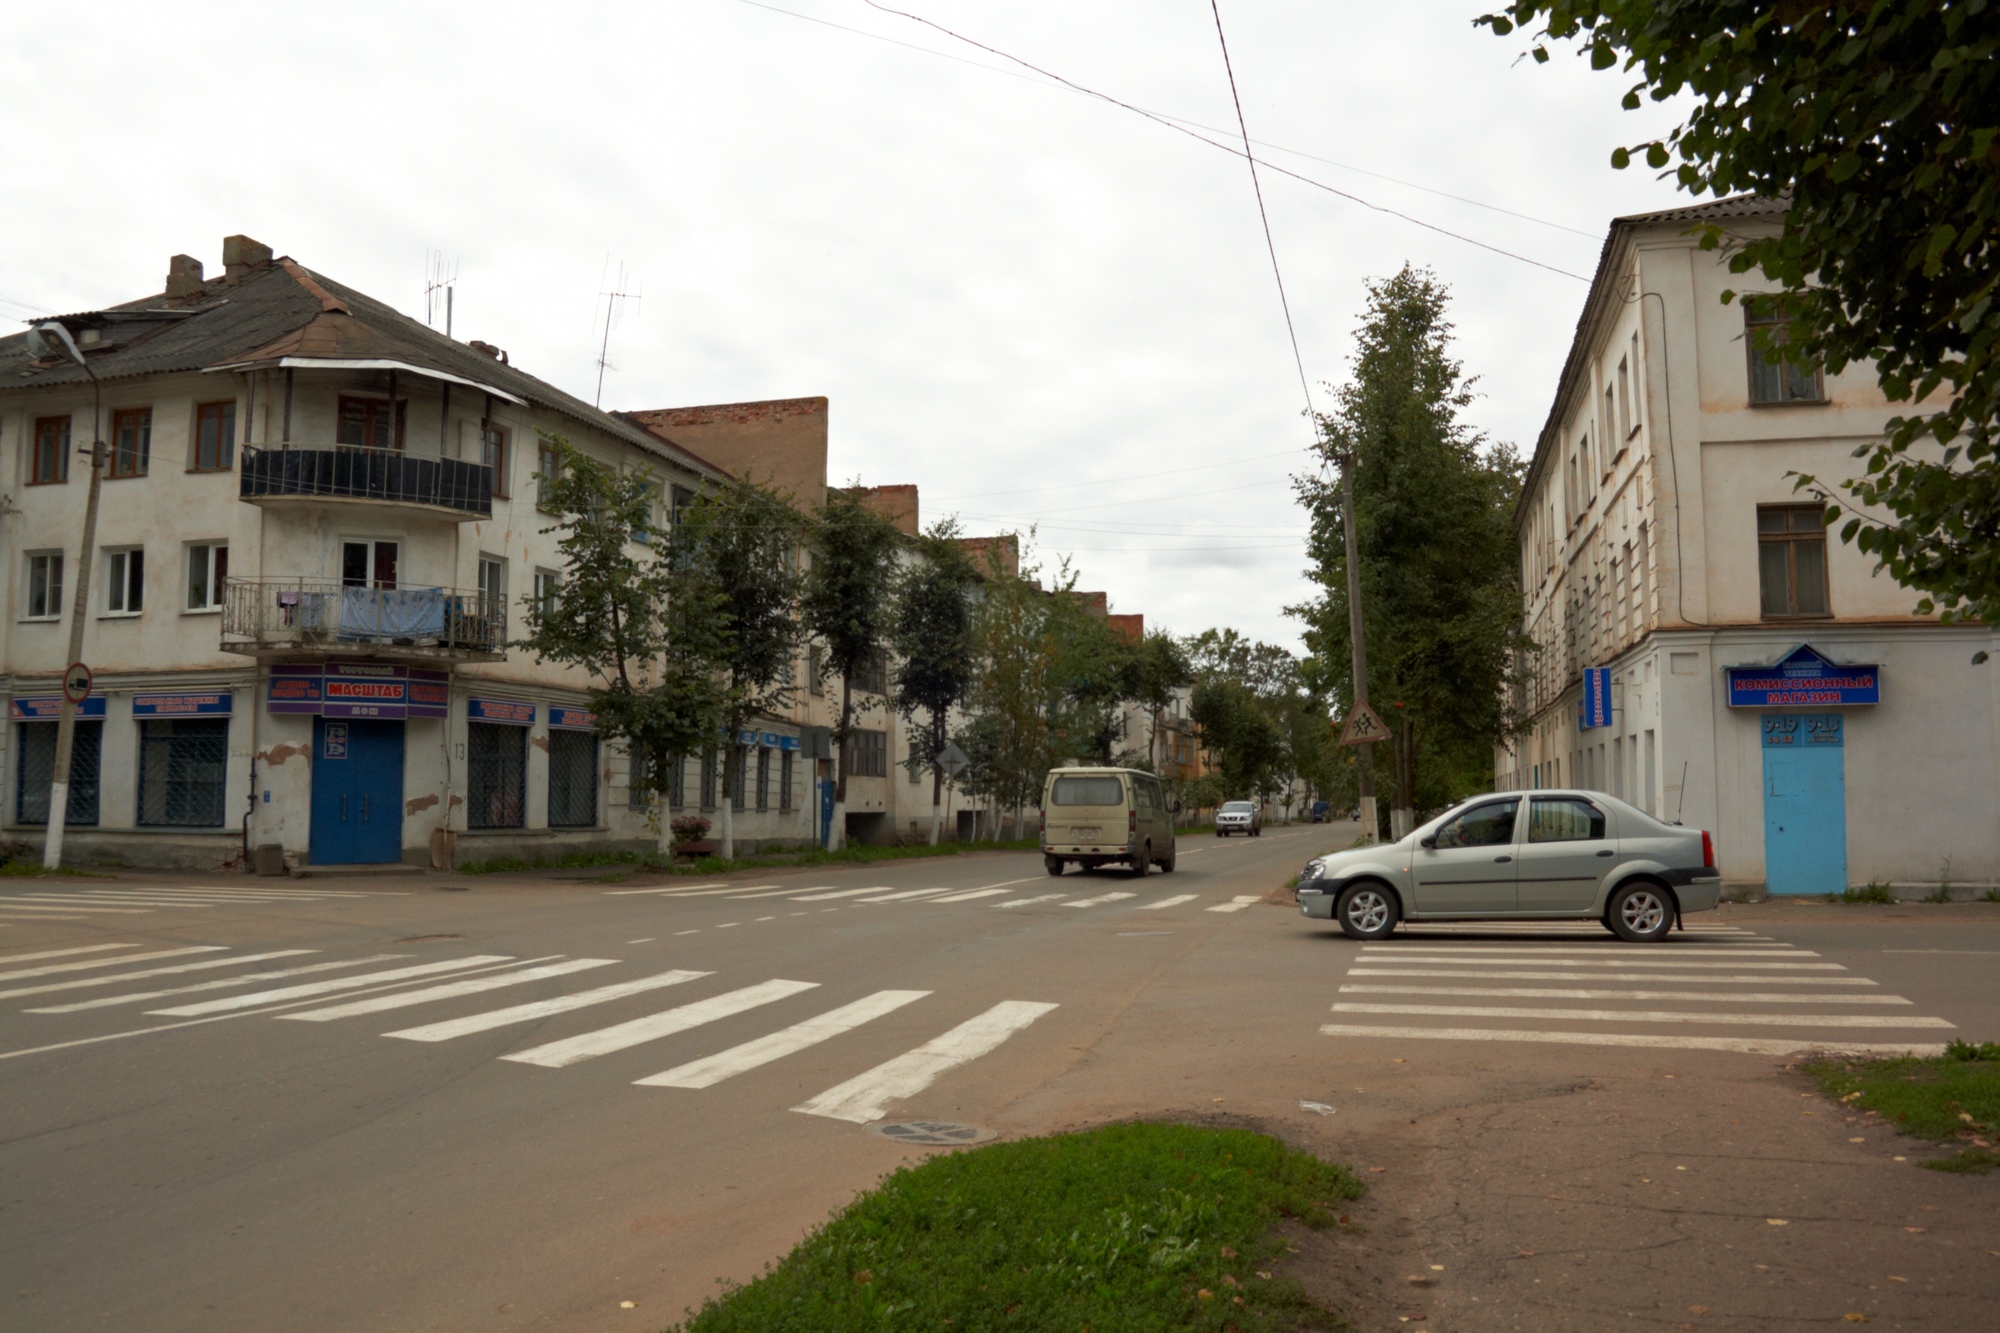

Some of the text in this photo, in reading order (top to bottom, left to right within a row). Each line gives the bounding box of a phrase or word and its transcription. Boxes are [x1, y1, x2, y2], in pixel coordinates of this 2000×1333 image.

[338, 665, 394, 675] ТОРГОВЫЙ
[1783, 669, 1821, 677] ТЕХНИКИ
[1734, 676, 1874, 691] КОМИССИОННЫЙ
[327, 682, 404, 698] МАСШТАБ
[135, 696, 219, 706] СТИРАЛЬНЫЕ МАШИНЫ
[1767, 691, 1841, 704] МАГАЗИН
[156, 704, 198, 712] ПЫЛЕСОСЫ
[351, 707, 378, 715] ДОМ
[455, 743, 464, 760] 13
